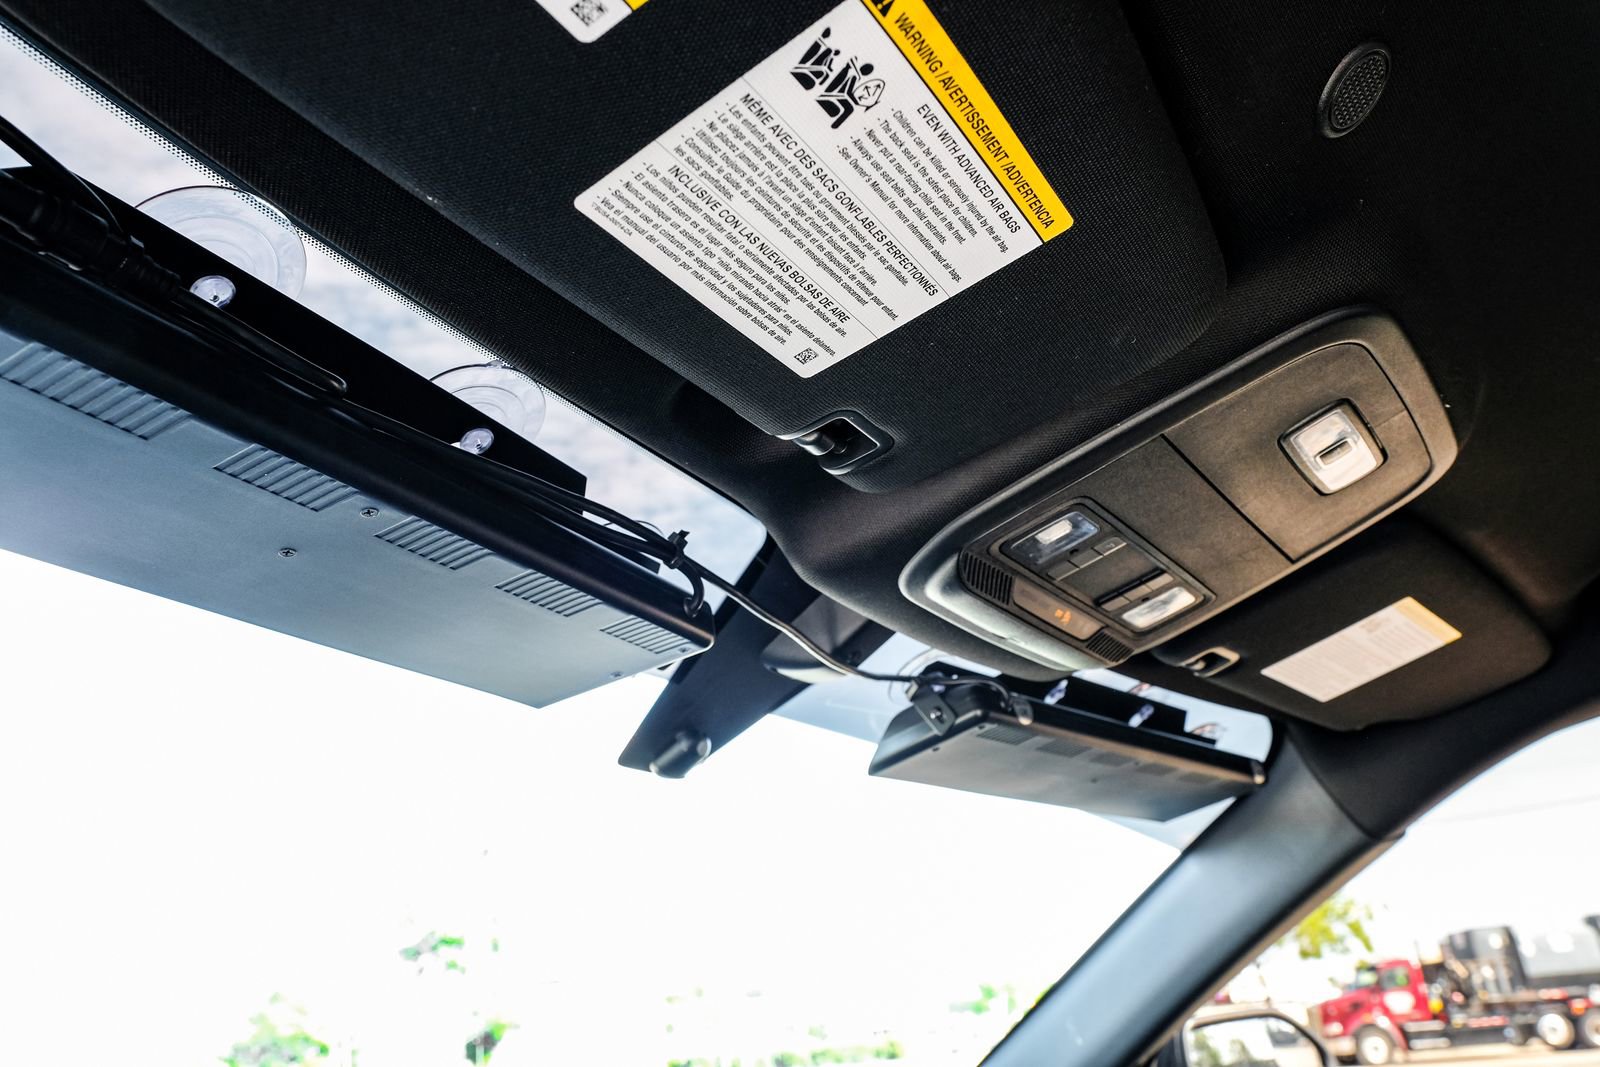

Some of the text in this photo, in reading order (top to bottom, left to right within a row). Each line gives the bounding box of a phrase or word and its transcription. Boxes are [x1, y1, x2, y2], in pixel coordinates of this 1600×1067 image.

[893, 11, 944, 75] WARNING
[633, 171, 791, 306] El asiento trasero es el lugar más seguro para los niños.
[673, 144, 734, 202] les sacs gonflables.
[684, 136, 870, 307] Consultez le Guide du propriétaire pour des renseignements concernant
[716, 112, 867, 261] Le siège arrière est la place la plus sûre pour les enfants.
[728, 104, 909, 287] Les enfants peuvent être tués ou gravement blessés par le sac gonflable.
[739, 92, 939, 297] MÊME AVEC DES SACS GONFLABLES PERFECTIONNÉS
[838, 146, 853, 161] See
[868, 180, 893, 204] Manual
[886, 200, 899, 211] for
[894, 208, 910, 225] more
[906, 220, 935, 252] information
[930, 248, 948, 265] about
[941, 262, 953, 271] air
[947, 267, 963, 284] bags.
[851, 138, 947, 246] Always use seat belts and child restraints.
[864, 128, 884, 149] Never
[877, 146, 894, 160] put
[892, 162, 923, 195] rear-facing
[918, 191, 936, 207] child
[929, 204, 945, 219] seat
[938, 214, 948, 224] in
[943, 220, 956, 232] the
[951, 228, 967, 246] front.
[879, 119, 978, 238] The back seat is the safest place for children.
[892, 109, 1009, 254] Children can be killed or seriously injured by the air bag.
[916, 103, 1022, 234] EVEN WITH ADVANCED AIR BAGS
[600, 196, 787, 346] Vea el manual del usuario por más información sobre bolsas de aire.
[610, 188, 641, 215] Siempre
[638, 212, 654, 225] use
[651, 222, 663, 231] el
[658, 228, 688, 252] cinturón
[684, 249, 696, 259] de
[692, 256, 726, 282] seguridad
[725, 281, 738, 292] los
[734, 289, 768, 316] sujetadores
[762, 313, 780, 325] para
[776, 322, 793, 337] niños.
[645, 163, 662, 179] Los
[658, 176, 680, 194] niños
[675, 191, 704, 215] pueden
[700, 212, 728, 234] resultar
[724, 231, 743, 247] fatal
[742, 248, 776, 276] seriamente
[772, 273, 800, 297] afectados
[794, 294, 810, 304] por
[805, 300, 817, 311] las
[813, 307, 832, 324] bolsas
[828, 321, 839, 329] de
[834, 326, 848, 338] aire.
[667, 164, 851, 324] INCLUSIVE CON LAS NUEVAS BOLSAS DE AIRE
